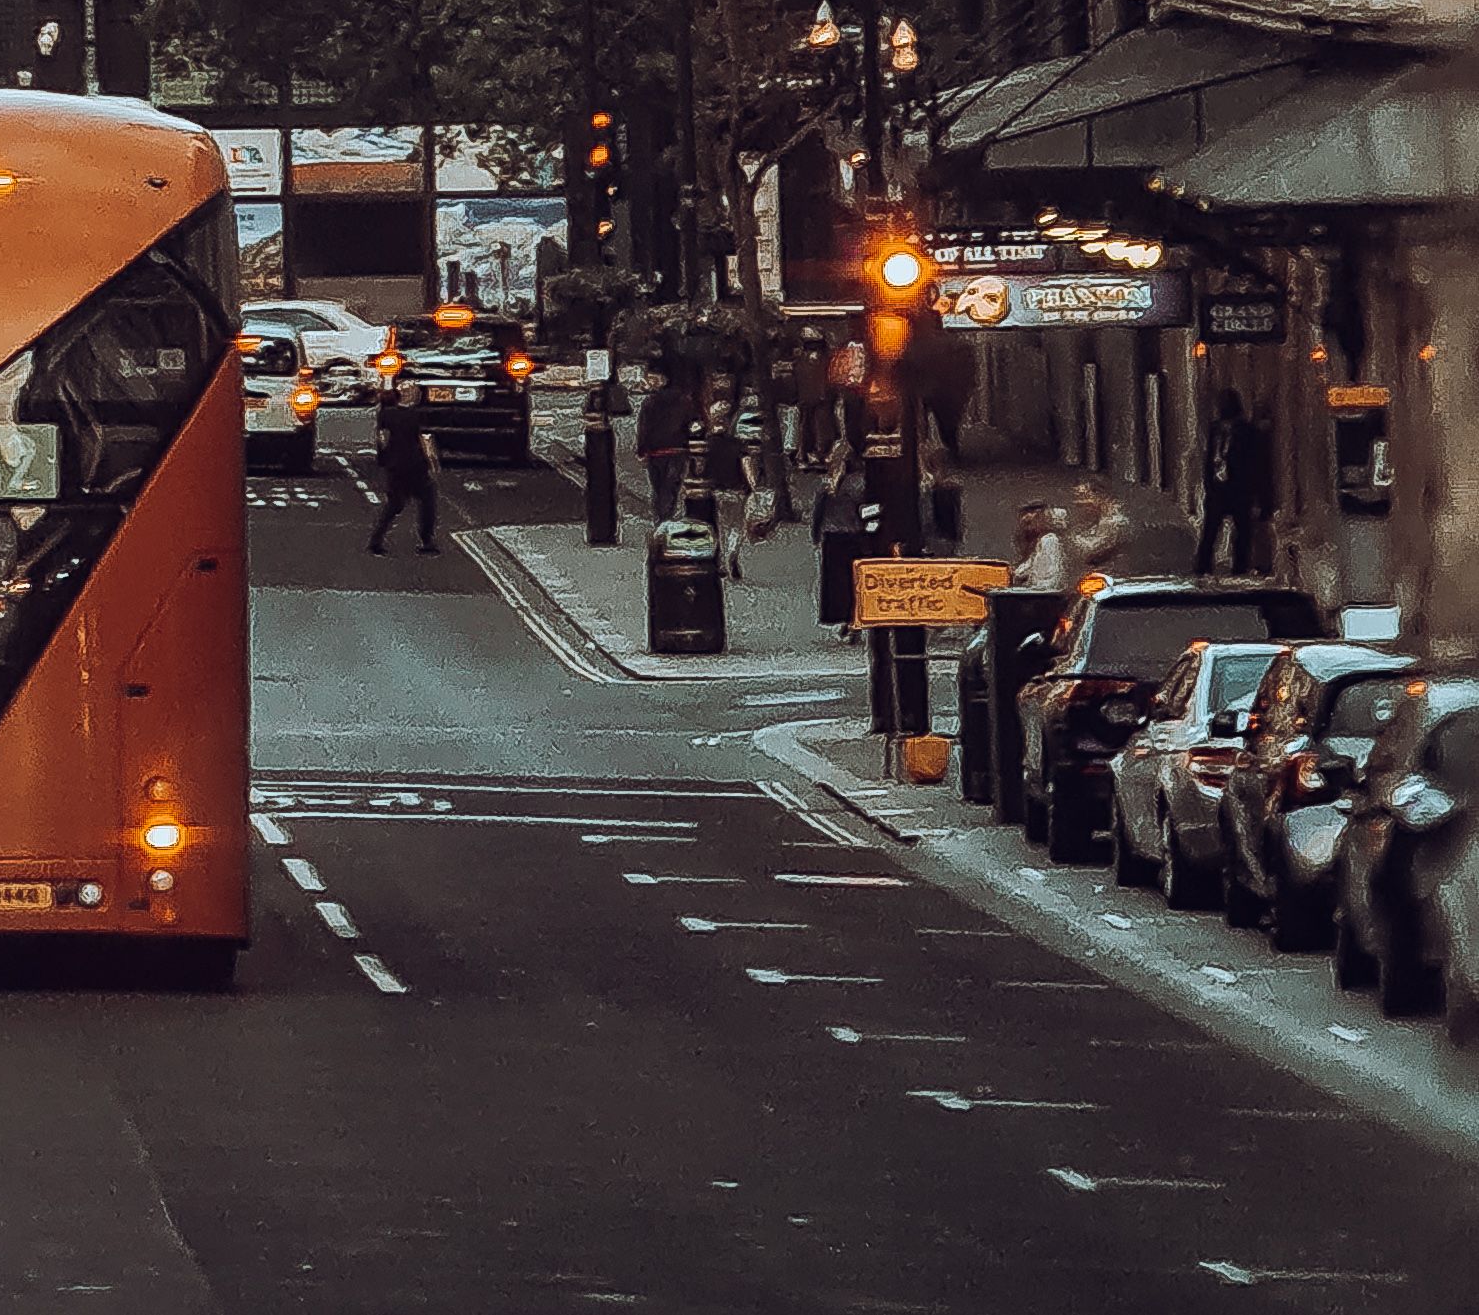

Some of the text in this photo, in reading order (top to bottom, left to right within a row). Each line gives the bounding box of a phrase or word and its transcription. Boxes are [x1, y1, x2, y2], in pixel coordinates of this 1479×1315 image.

[963, 246, 996, 262] ALL
[864, 570, 955, 591] Diverted
[876, 594, 945, 616] traffic
